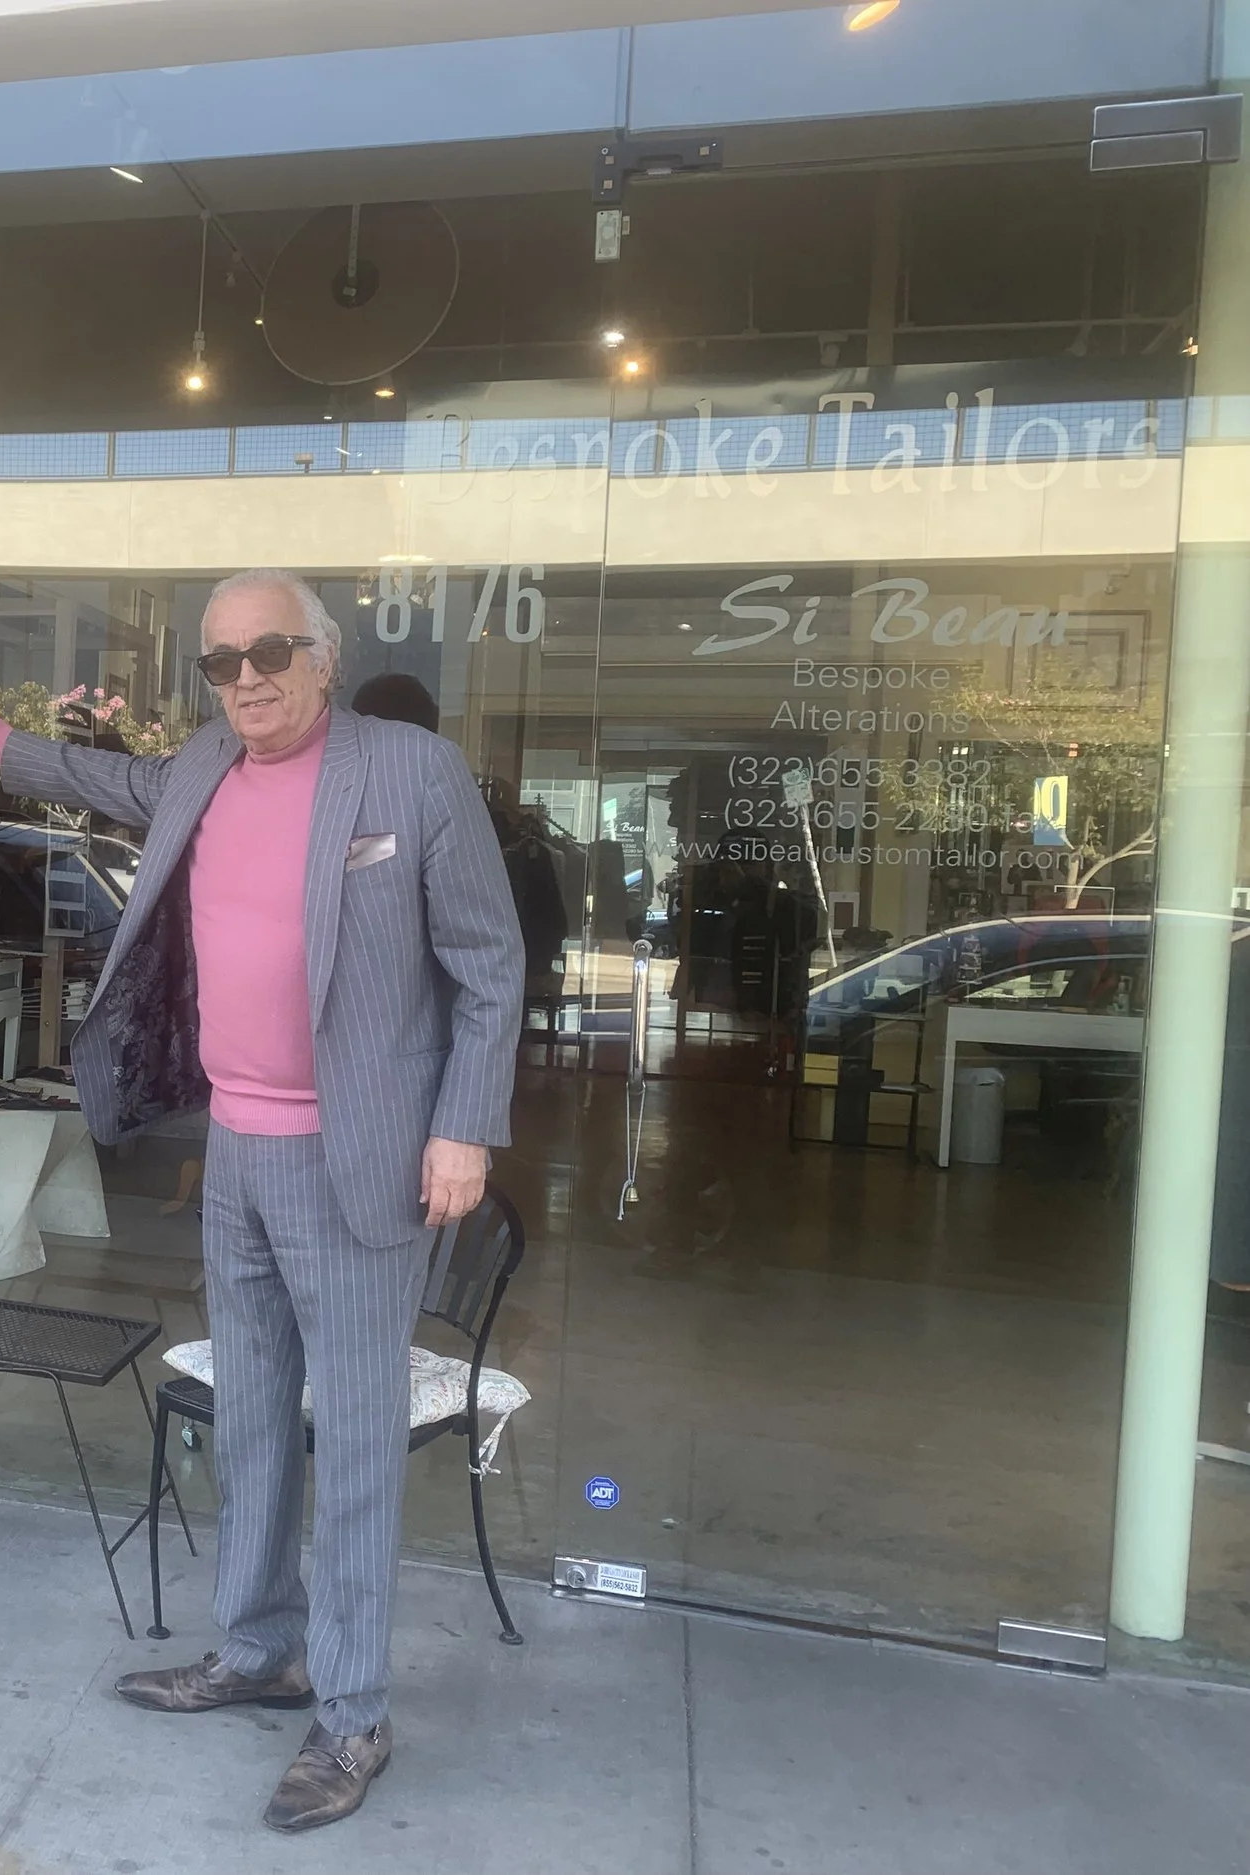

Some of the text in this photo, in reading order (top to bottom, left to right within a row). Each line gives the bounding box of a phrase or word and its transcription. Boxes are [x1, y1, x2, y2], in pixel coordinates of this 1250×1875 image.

[818, 388, 1161, 495] Tailors
[376, 560, 545, 643] 8176
[692, 574, 1070, 655] Si Beau
[793, 658, 950, 694] Bespoke
[770, 701, 970, 734] Alterations
[591, 1486, 614, 1500] ADT
